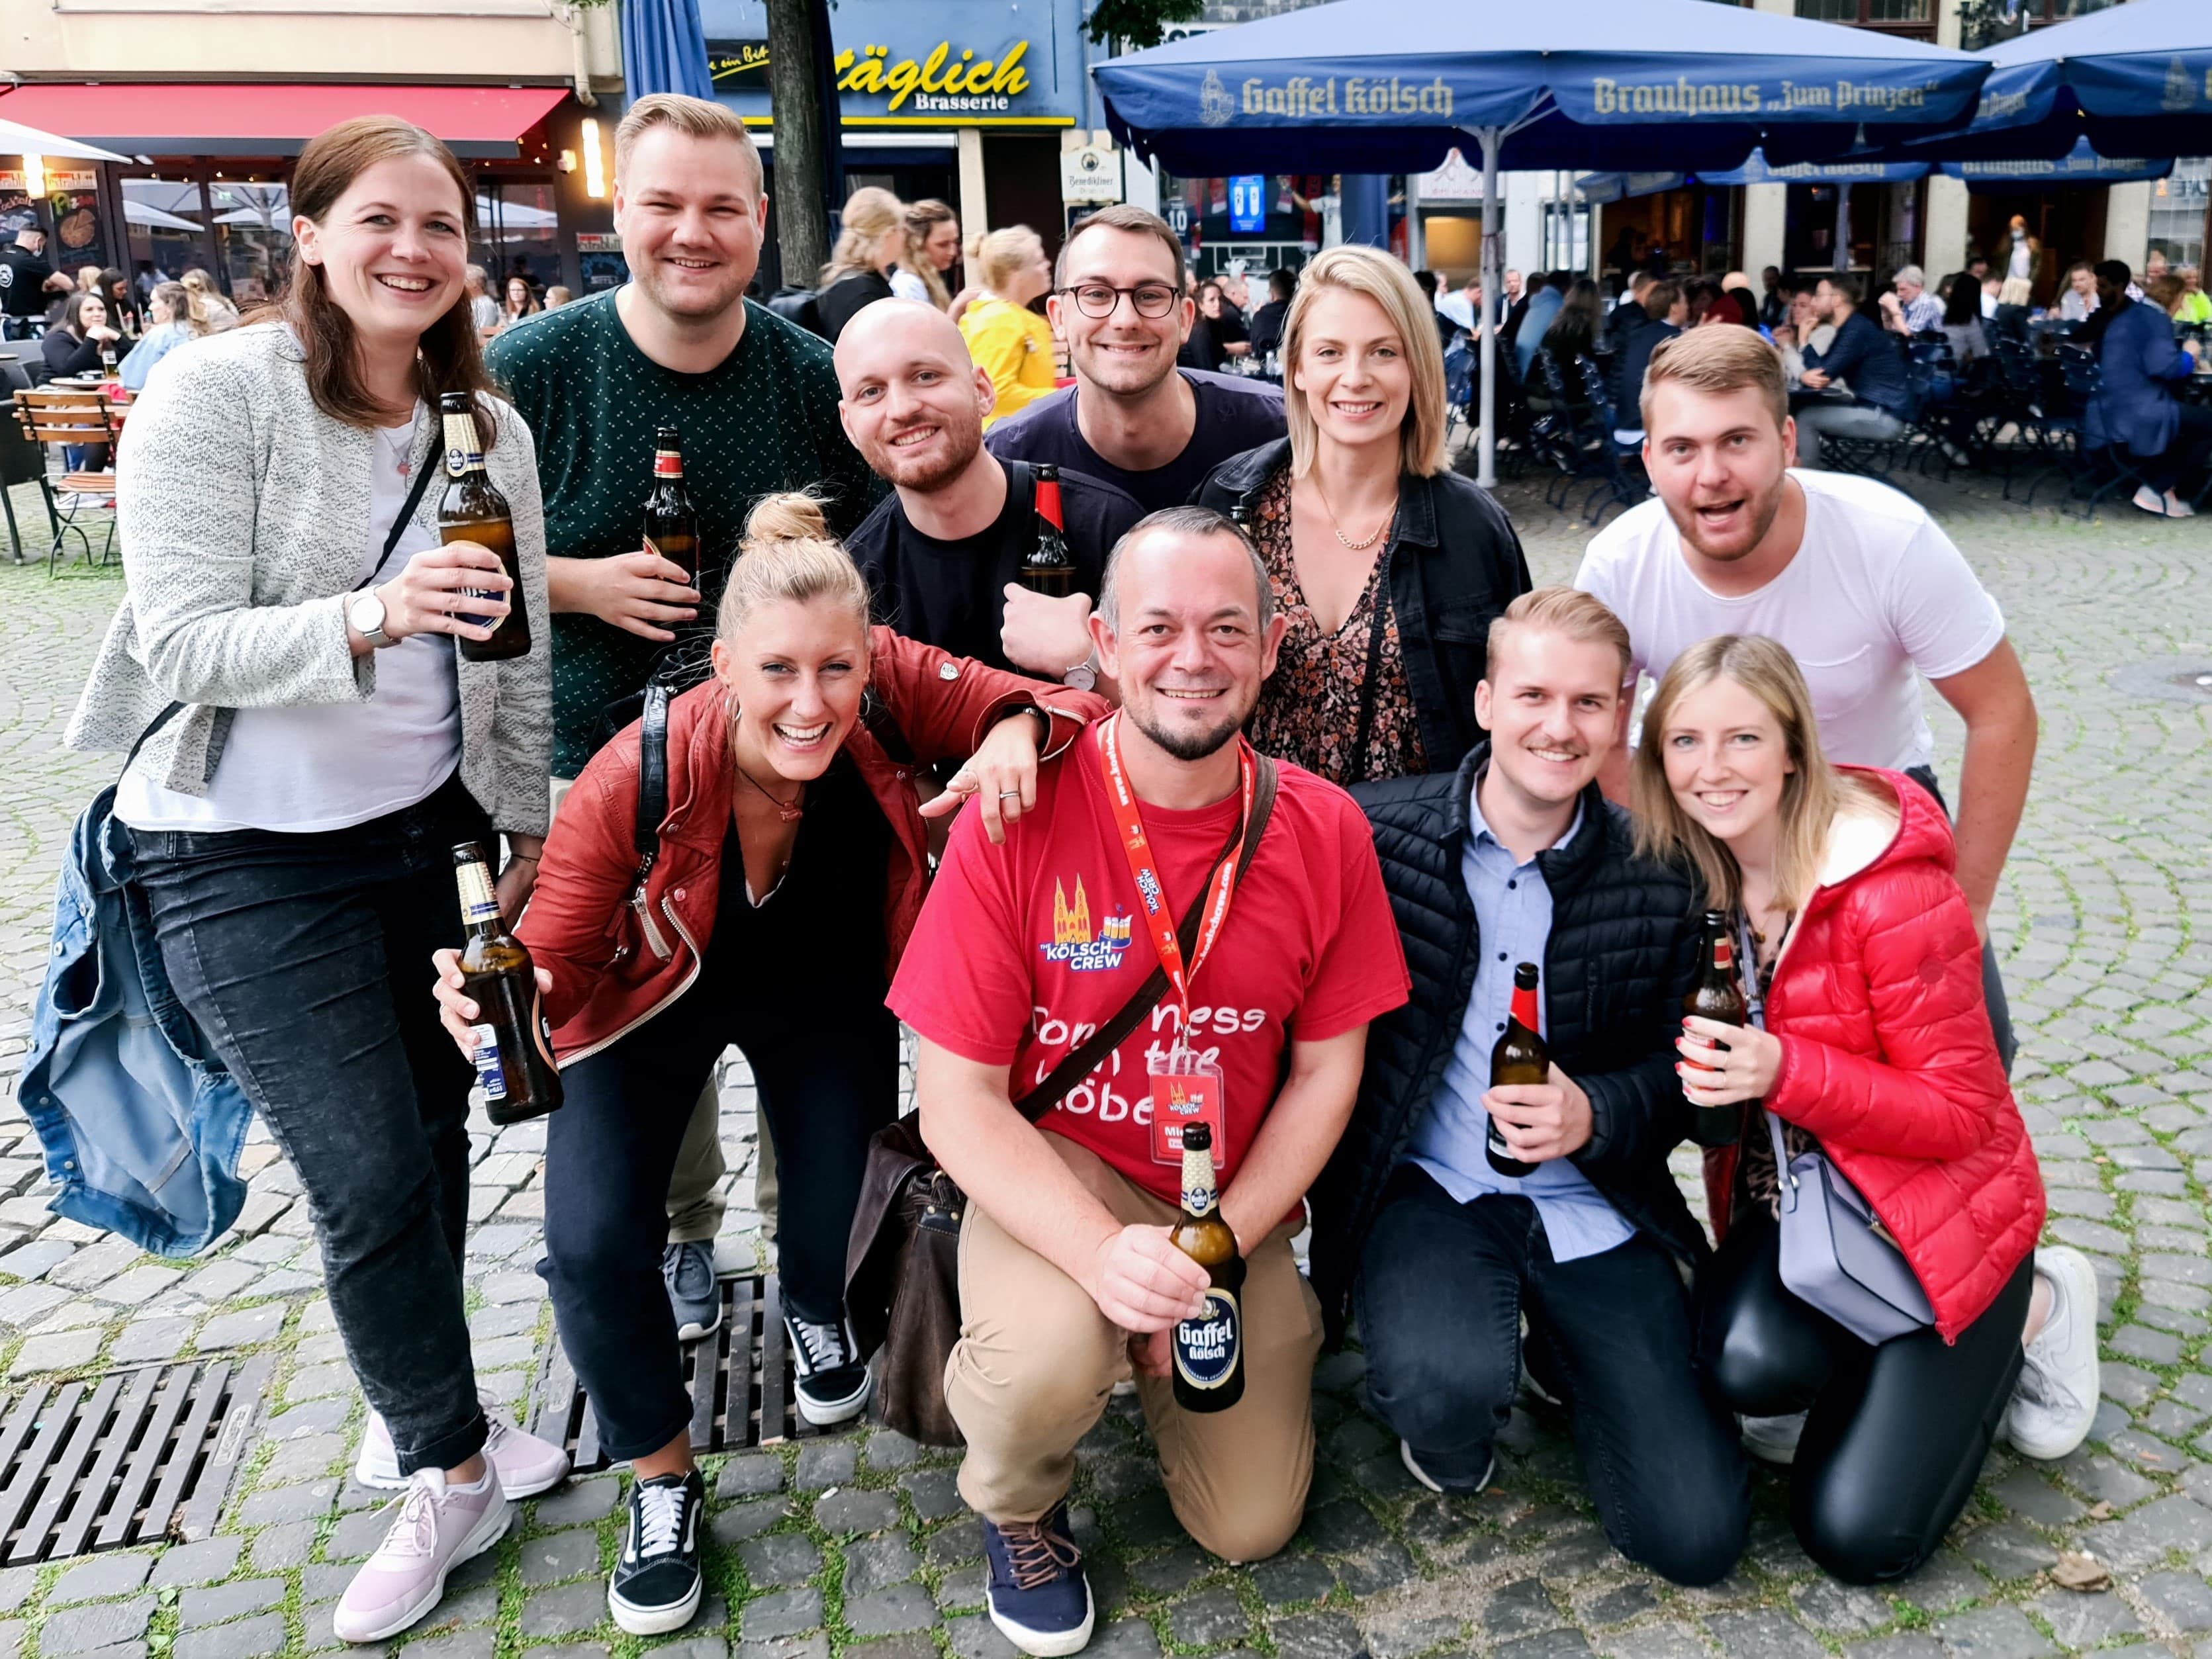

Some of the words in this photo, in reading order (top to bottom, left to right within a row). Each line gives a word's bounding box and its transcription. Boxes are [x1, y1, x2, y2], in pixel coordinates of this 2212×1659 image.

[915, 93, 1009, 111] Brasserie
[1242, 76, 1339, 117] Gaffel
[1345, 76, 1453, 118] Kölsch
[1592, 76, 1760, 116] Brauhaus
[1046, 940, 1111, 960] KÖLSCH
[1070, 953, 1122, 970] CREW
[1144, 1036, 1221, 1076] the
[1179, 1317, 1234, 1347] Gaffel
[1189, 1344, 1225, 1360] Kölsch
